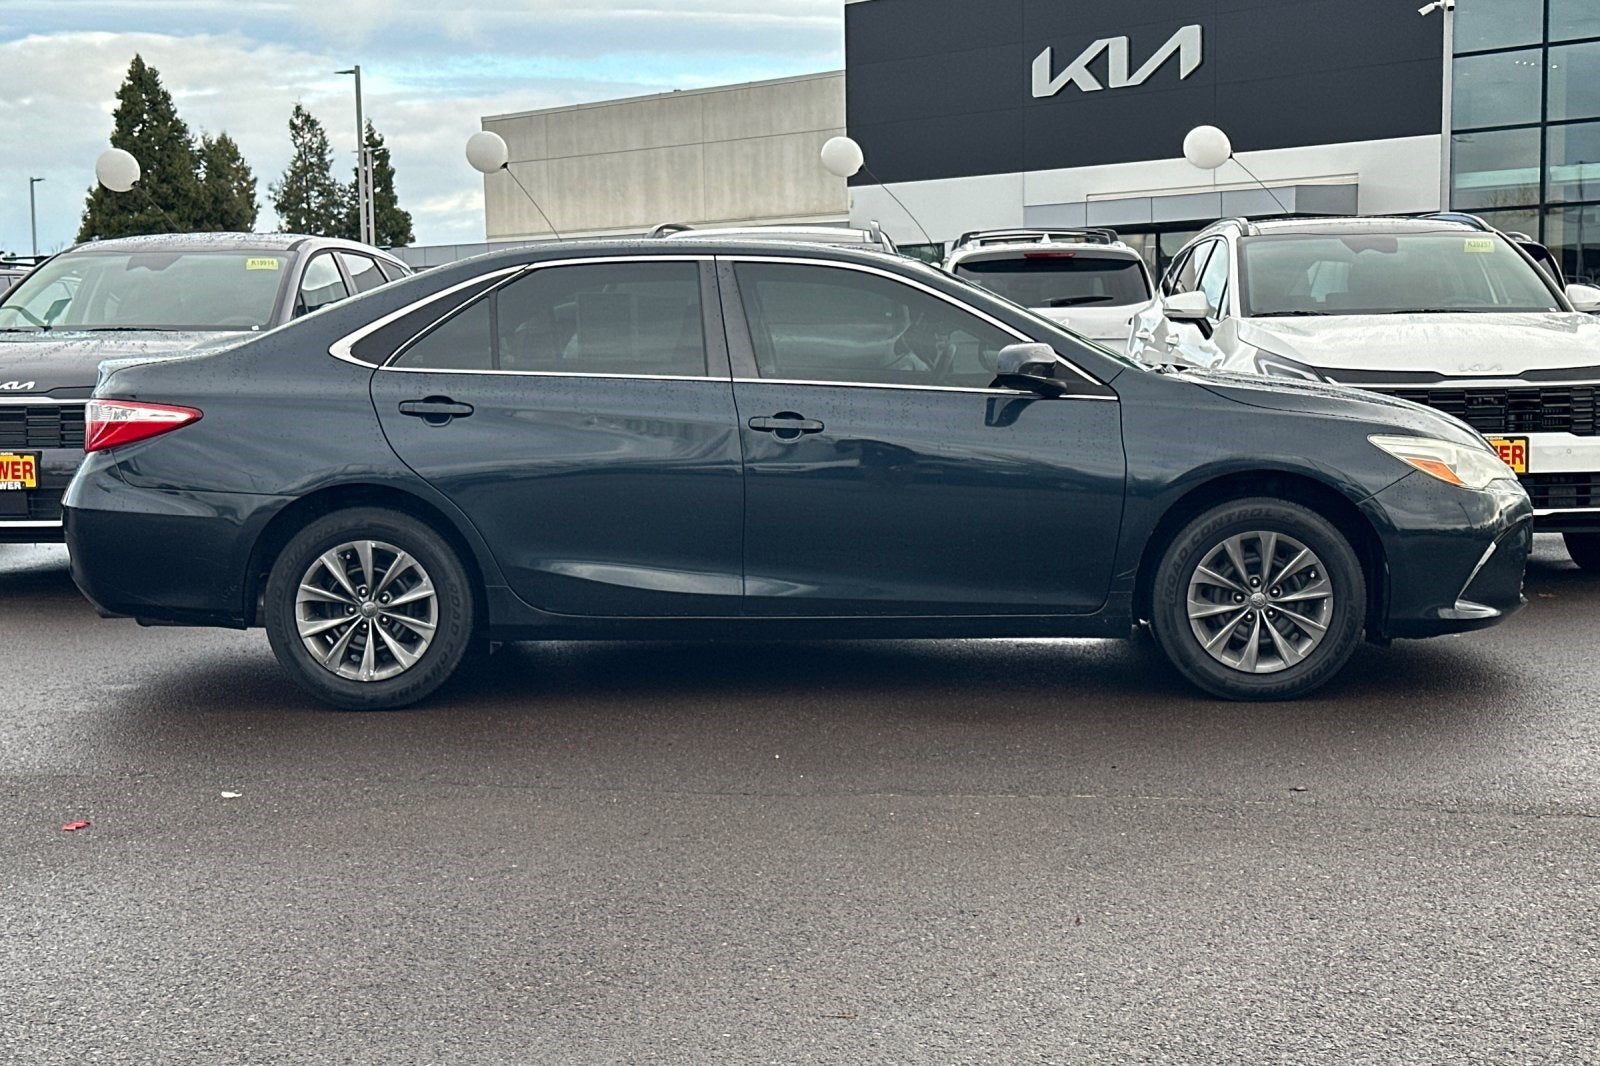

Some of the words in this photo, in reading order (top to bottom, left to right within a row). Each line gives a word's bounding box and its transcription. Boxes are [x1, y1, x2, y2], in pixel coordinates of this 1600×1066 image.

[1032, 25, 1202, 98] KIA
[1495, 445, 1525, 465] ER
[1166, 546, 1188, 602] ROAD
[1191, 507, 1273, 545] CONTROL
